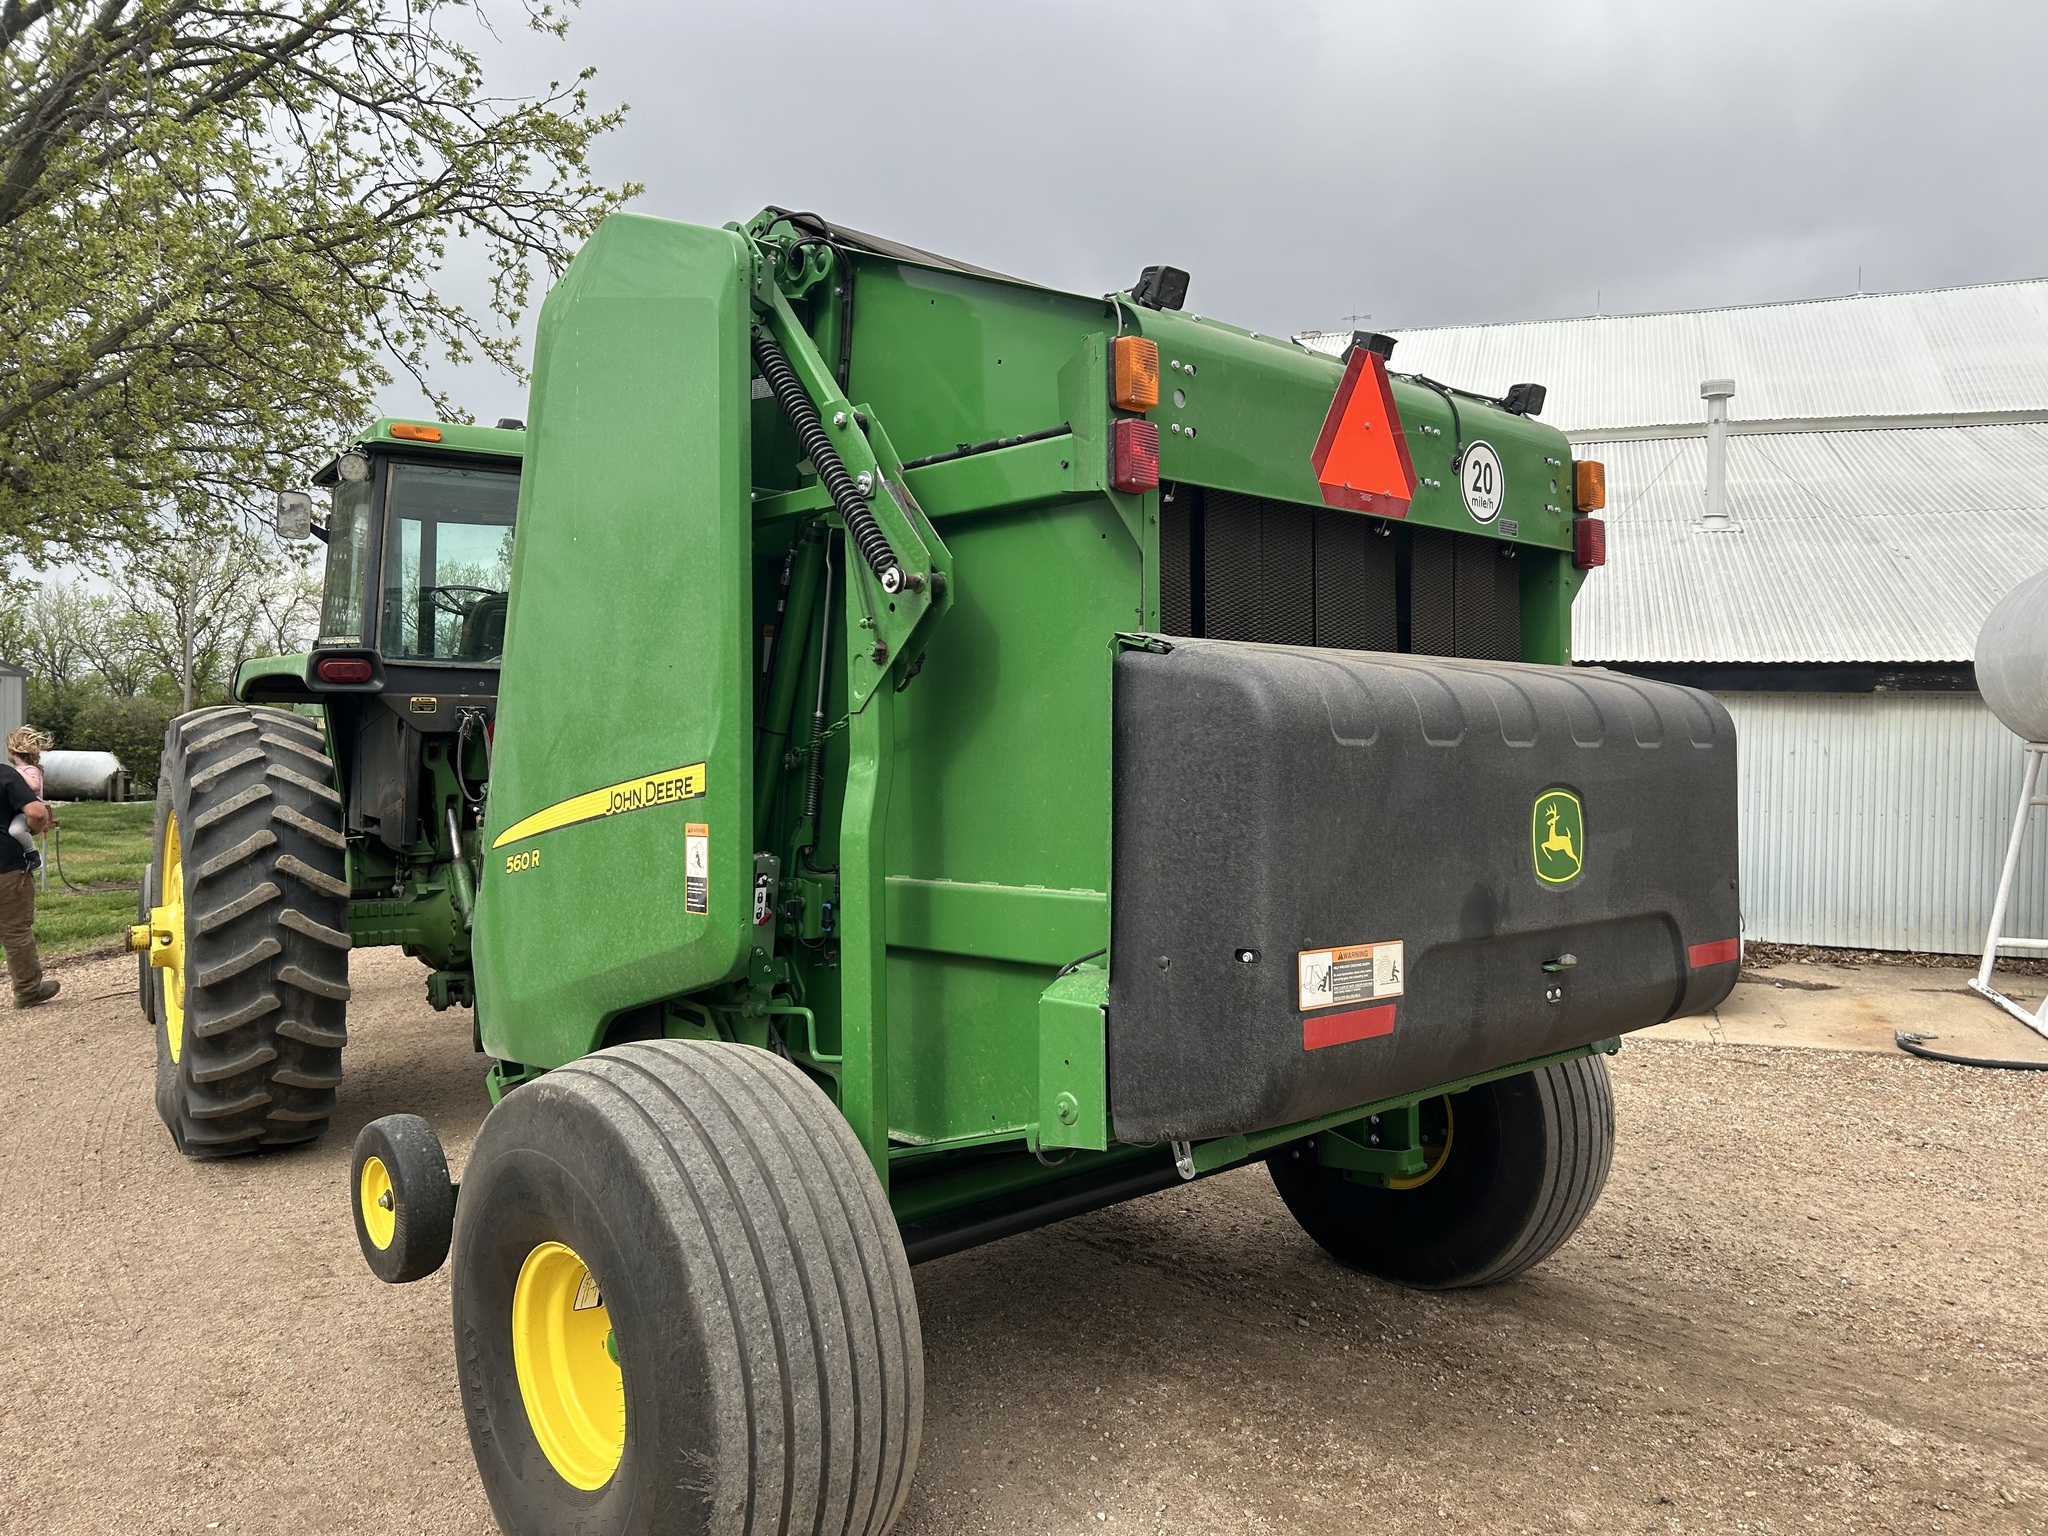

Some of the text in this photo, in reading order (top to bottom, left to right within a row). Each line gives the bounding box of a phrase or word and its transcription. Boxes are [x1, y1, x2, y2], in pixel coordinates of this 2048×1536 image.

[1472, 460, 1492, 495] 20
[606, 776, 693, 812] JOHN DEERE
[506, 848, 541, 874] 560 R
[1343, 950, 1368, 959] WARNING
[464, 1319, 495, 1448] TITAN
